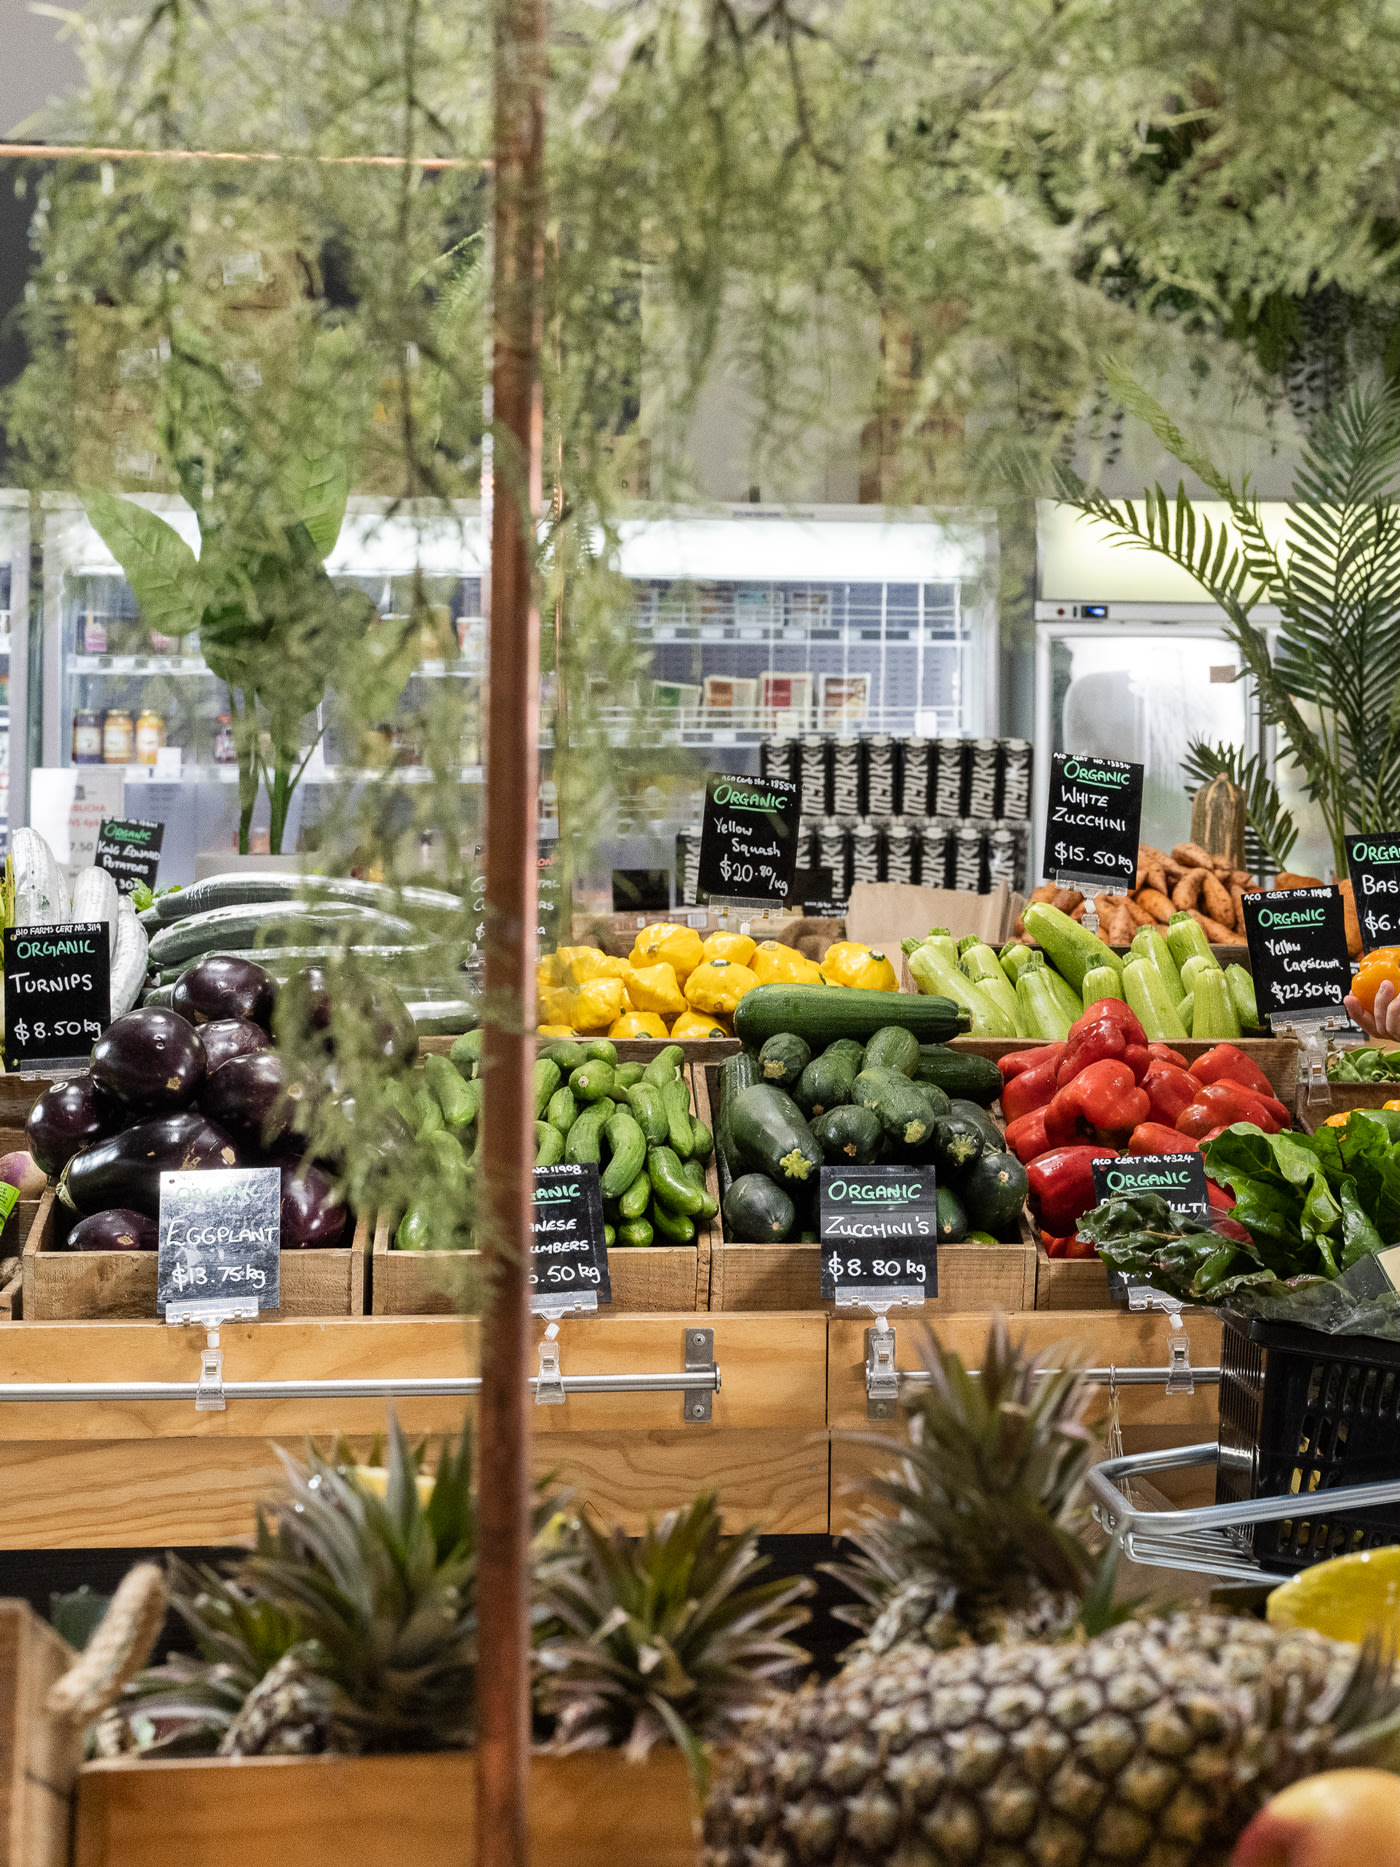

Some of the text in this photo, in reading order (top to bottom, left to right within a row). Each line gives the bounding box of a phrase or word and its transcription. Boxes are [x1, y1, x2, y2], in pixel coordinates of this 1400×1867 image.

[1064, 760, 1131, 786] ORGANIC
[713, 783, 788, 810] ORGANIC
[1061, 784, 1109, 808] WHITE
[713, 816, 753, 836] Yellow
[1052, 806, 1126, 832] ZUCCHINI
[104, 823, 152, 841] ORGANIC
[731, 837, 781, 858] Squash
[1244, 893, 1261, 901] ACO
[1266, 890, 1290, 899] CERT
[1258, 908, 1326, 928] ORGANIC
[55, 924, 73, 934] CERT
[17, 940, 96, 959] ORGANIC
[1264, 938, 1301, 956] Yellow
[9, 972, 93, 995] TURNIPS
[550, 1164, 582, 1175] 11908
[1092, 1154, 1195, 1166] ACO CERT NO. 4324
[828, 1180, 922, 1201] ORGANIC
[1106, 1170, 1192, 1191] ORGANIC
[167, 1219, 279, 1246] EGGPLANT
